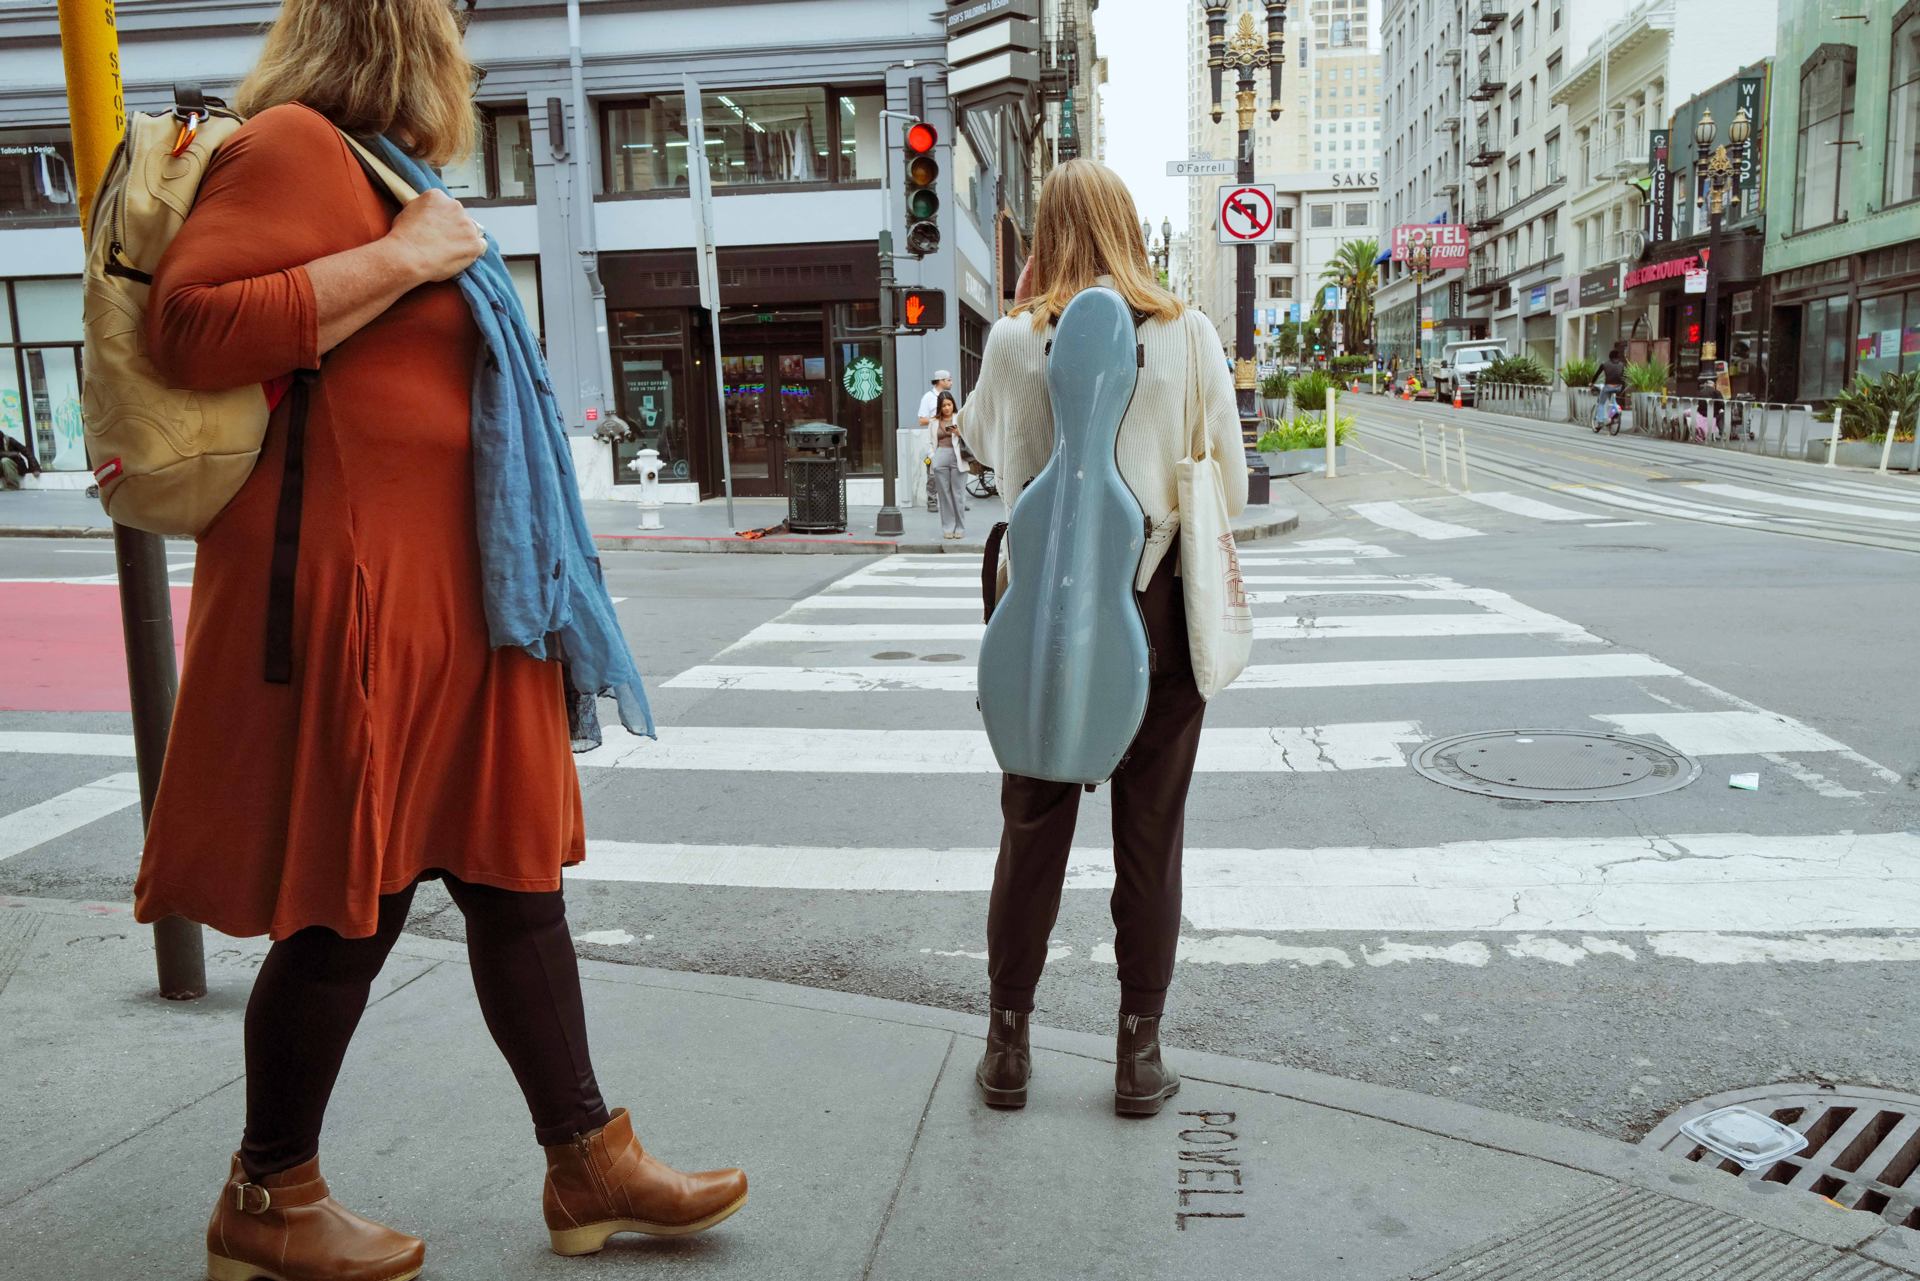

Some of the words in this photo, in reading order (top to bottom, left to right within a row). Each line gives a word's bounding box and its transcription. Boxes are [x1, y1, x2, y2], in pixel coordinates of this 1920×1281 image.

[110, 52, 123, 131] STOP
[1742, 84, 1756, 126] WIN
[1, 147, 27, 155] Tailoring
[34, 146, 56, 154] Design
[1176, 163, 1225, 173] O'Farrell
[1739, 137, 1752, 183] SHOP
[1332, 172, 1379, 187] SAKS
[1656, 163, 1666, 241] COCKTAILS
[1396, 226, 1465, 246] HOTEL
[1175, 1110, 1246, 1231] POWELL
